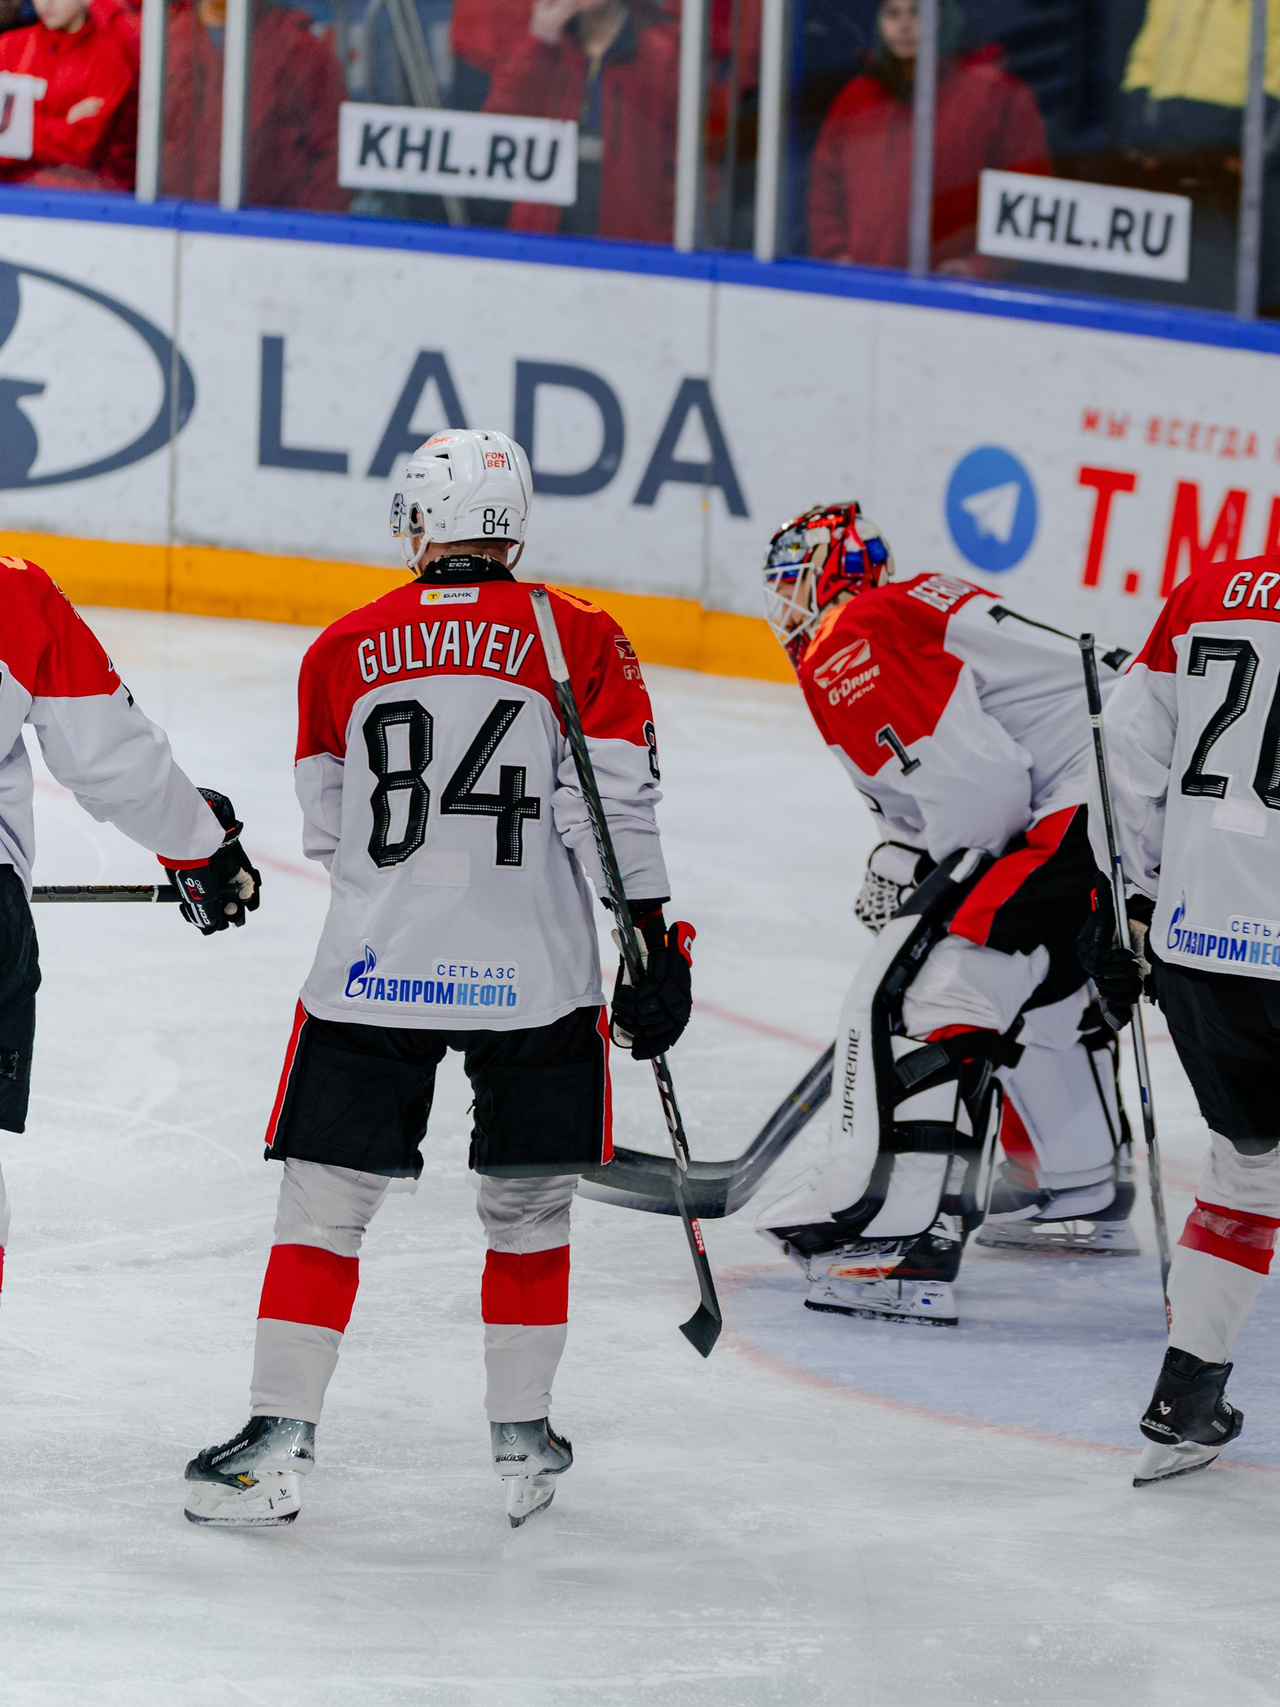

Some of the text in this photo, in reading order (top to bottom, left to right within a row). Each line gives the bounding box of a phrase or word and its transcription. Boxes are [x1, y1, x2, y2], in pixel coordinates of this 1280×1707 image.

[357, 121, 560, 184] KHL.RU
[999, 191, 1175, 259] KHL.RU
[257, 334, 750, 520] LADA
[1082, 405, 1131, 439] МЫ
[1146, 414, 1257, 461] ВСЕГДА
[485, 452, 504, 460] FON
[487, 460, 506, 468] BET
[483, 508, 510, 535] 84
[357, 620, 536, 685] GULYAYEV
[847, 682, 876, 707] АРЕНА
[876, 723, 922, 777] 1
[362, 697, 542, 869] 84
[184, 877, 203, 901] FT6
[196, 903, 211, 925] CCM
[1231, 920, 1272, 937] СЕТЬ
[437, 963, 516, 980] СЕТЬ АЗС
[365, 977, 517, 1008] ГАЗПРОМНЕФТЬ
[842, 1028, 861, 1138] SUPREME
[211, 1439, 250, 1466] BAUER
